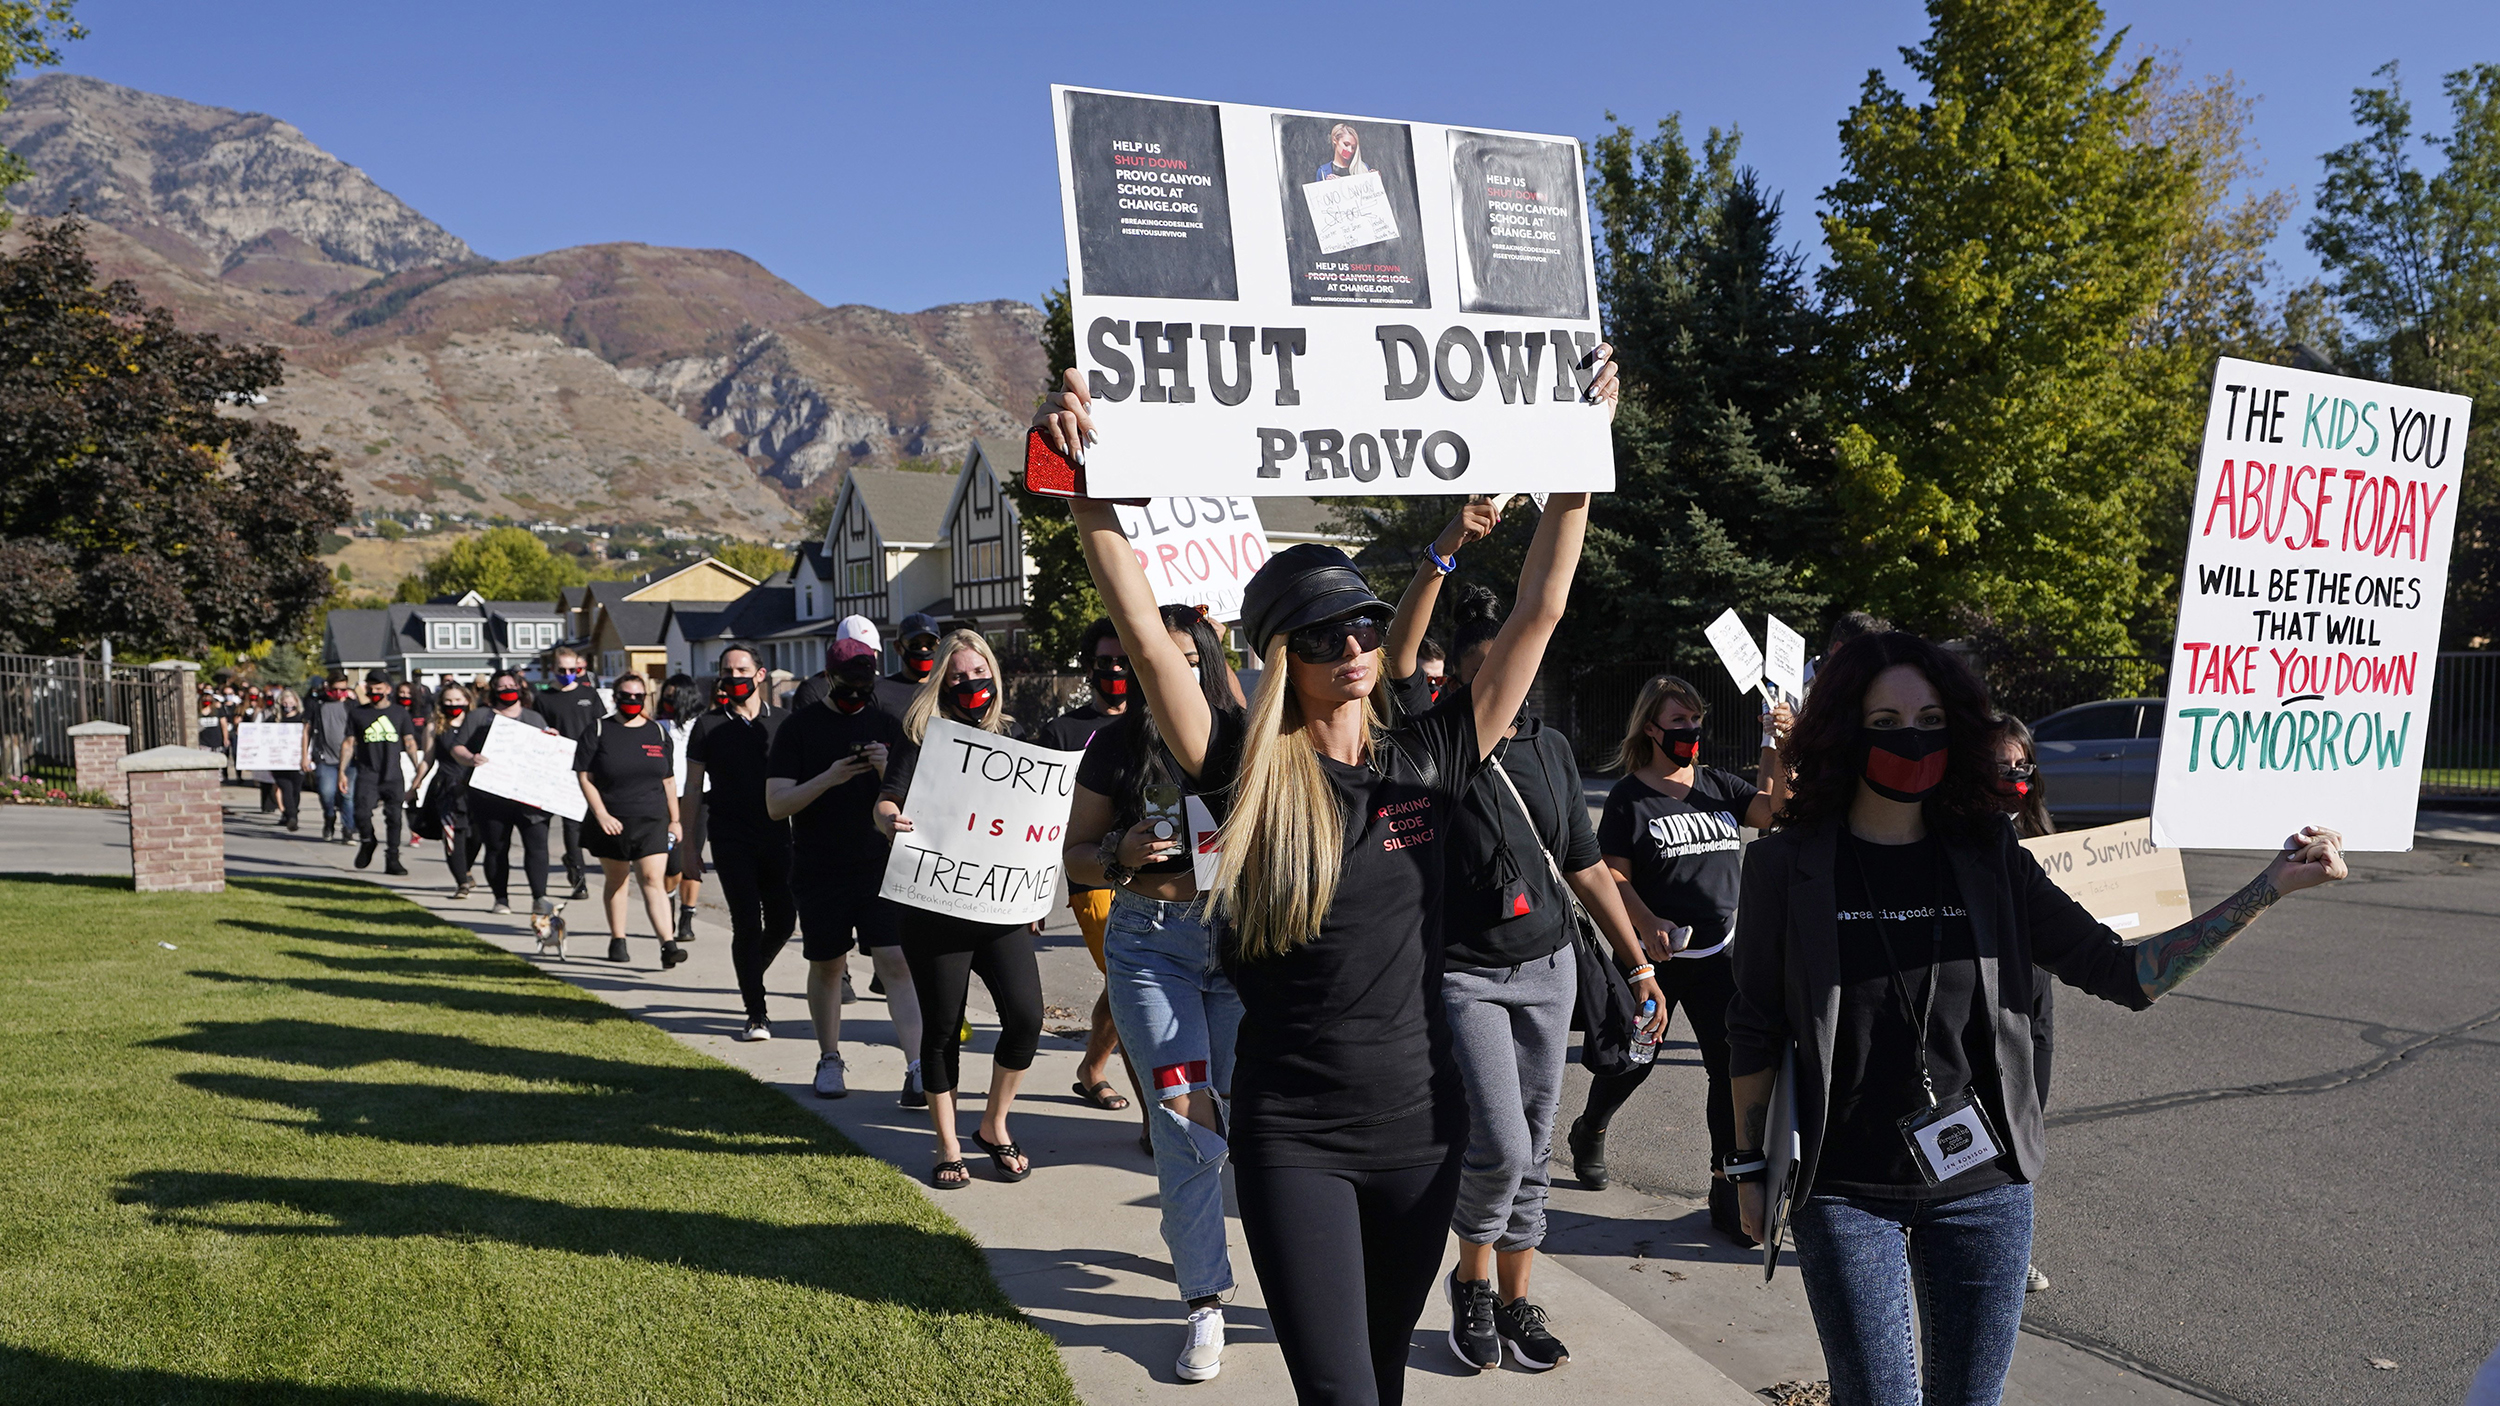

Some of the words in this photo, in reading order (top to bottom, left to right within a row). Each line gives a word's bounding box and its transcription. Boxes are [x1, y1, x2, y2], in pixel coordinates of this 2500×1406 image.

[1113, 140, 1142, 152] HELP
[1145, 143, 1161, 154] US
[1115, 155, 1145, 166] SHUT
[1148, 158, 1187, 170] DOWN
[1116, 169, 1158, 182] PROVO
[1160, 173, 1211, 186] CANYON
[1486, 174, 1510, 185] HELP
[1513, 178, 1526, 187] US
[1118, 184, 1167, 197] SCHOOL
[1169, 188, 1183, 198] AT
[1488, 187, 1512, 198] SHUT
[1119, 198, 1198, 213] CHANGE.ORG
[1489, 201, 1522, 212] PROVO
[1525, 204, 1567, 217] CANYON
[1121, 218, 1203, 229] #BREAKINGCODESILENCE
[1490, 213, 1530, 226] SCHOOL
[1532, 218, 1544, 227] AT
[1122, 228, 1187, 238] #ISEEYOUSURVIVOR
[1491, 226, 1556, 241] CHANGE.ORG
[1492, 244, 1561, 254] #BREAKINGCODESILENCE
[1316, 262, 1336, 271] HELP
[1338, 263, 1349, 271] US
[1350, 264, 1372, 272] SHUT
[1374, 264, 1400, 272] DOWN
[1308, 272, 1338, 280] PROVO
[1339, 273, 1375, 282] CANYON
[1376, 275, 1410, 284] SCHOOL
[1328, 284, 1338, 292] AT
[1340, 284, 1394, 293] CHANGE.ORG
[1088, 316, 1306, 406] SHUT
[1376, 324, 1596, 405] DOWN
[2226, 384, 2289, 443] THE
[2302, 393, 2379, 457] KIDS
[2390, 406, 2451, 468] YOU
[1256, 427, 1470, 482] PROVO
[2203, 459, 2338, 550] ABUSE
[2342, 470, 2448, 562] TODAY
[2199, 564, 2259, 597] WILL
[2268, 568, 2299, 602] BE
[2303, 569, 2352, 605] THE
[2355, 576, 2421, 609] ONES
[2253, 610, 2321, 642] THAT
[2326, 614, 2381, 646] WILL
[2183, 642, 2260, 695] TAKE
[2270, 647, 2332, 698] YOU
[2334, 651, 2418, 697] DOWN
[2179, 708, 2412, 773] TOMORROW
[953, 738, 1078, 796] TORTU
[968, 812, 1004, 836] IS
[1026, 822, 1068, 842] NO
[1389, 816, 1424, 832] CODE
[1648, 810, 1740, 848] SURVIVOR
[904, 844, 1059, 902] TREATME
[892, 882, 1013, 915] #BreakingCodeSilence
[1837, 906, 1967, 921] #breaingcodeile
